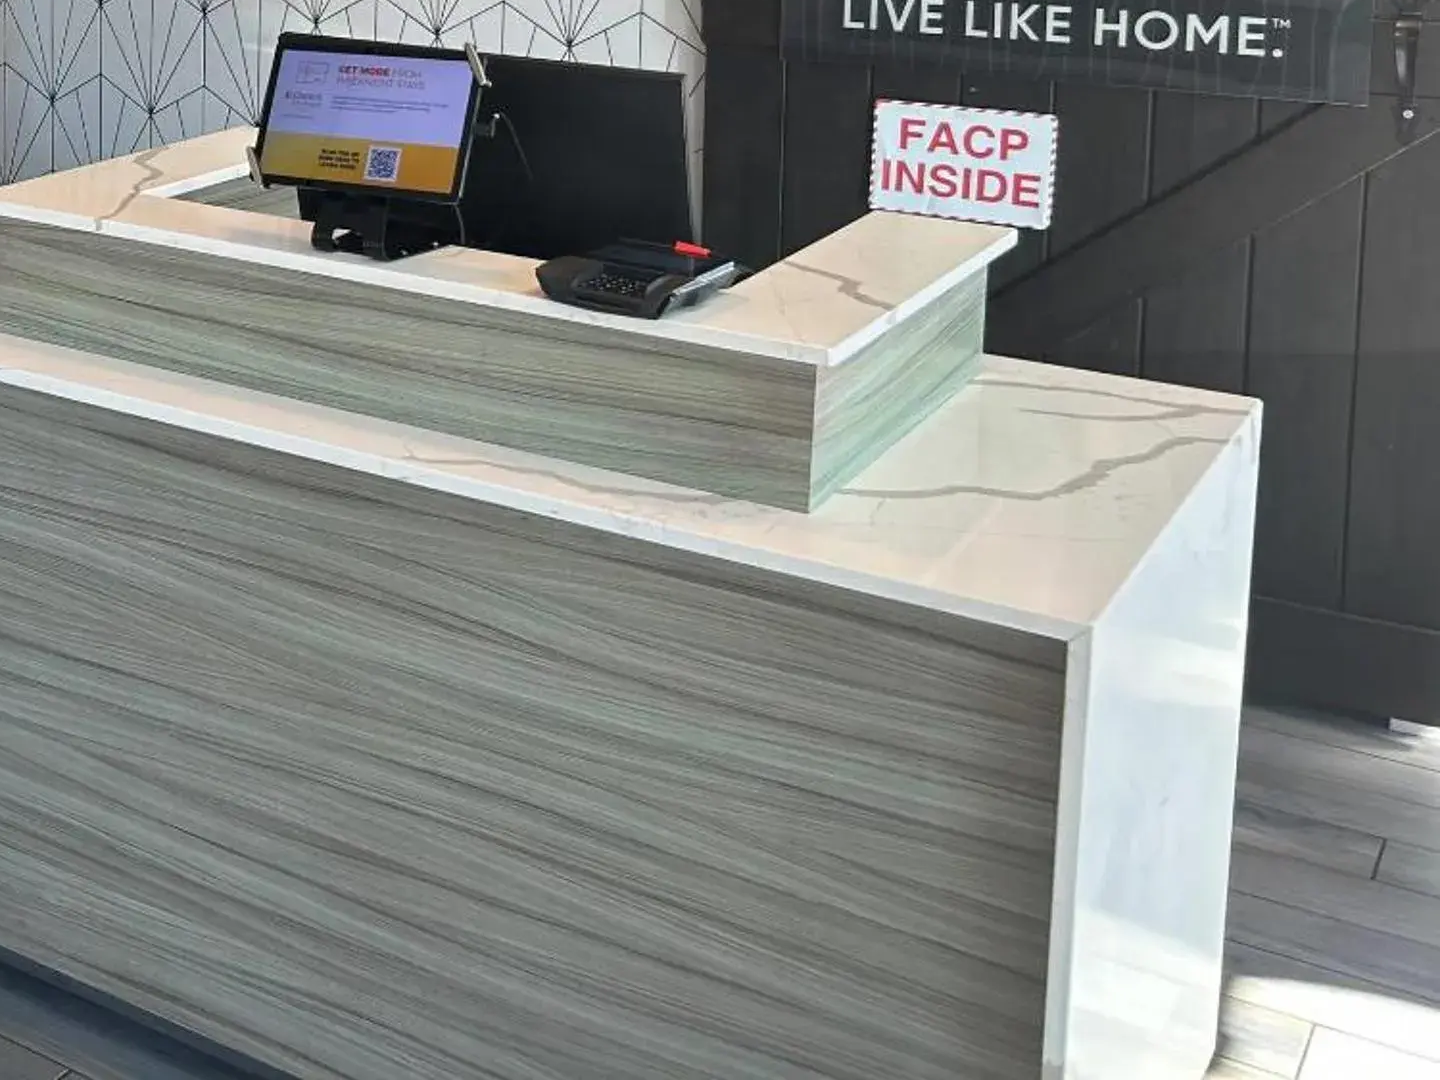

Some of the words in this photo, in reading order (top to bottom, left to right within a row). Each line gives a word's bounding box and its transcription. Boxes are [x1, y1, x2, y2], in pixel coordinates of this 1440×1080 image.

[966, 1, 1071, 43] LIKE
[898, 118, 1029, 160] FACP
[880, 159, 1041, 208] INSIDE
